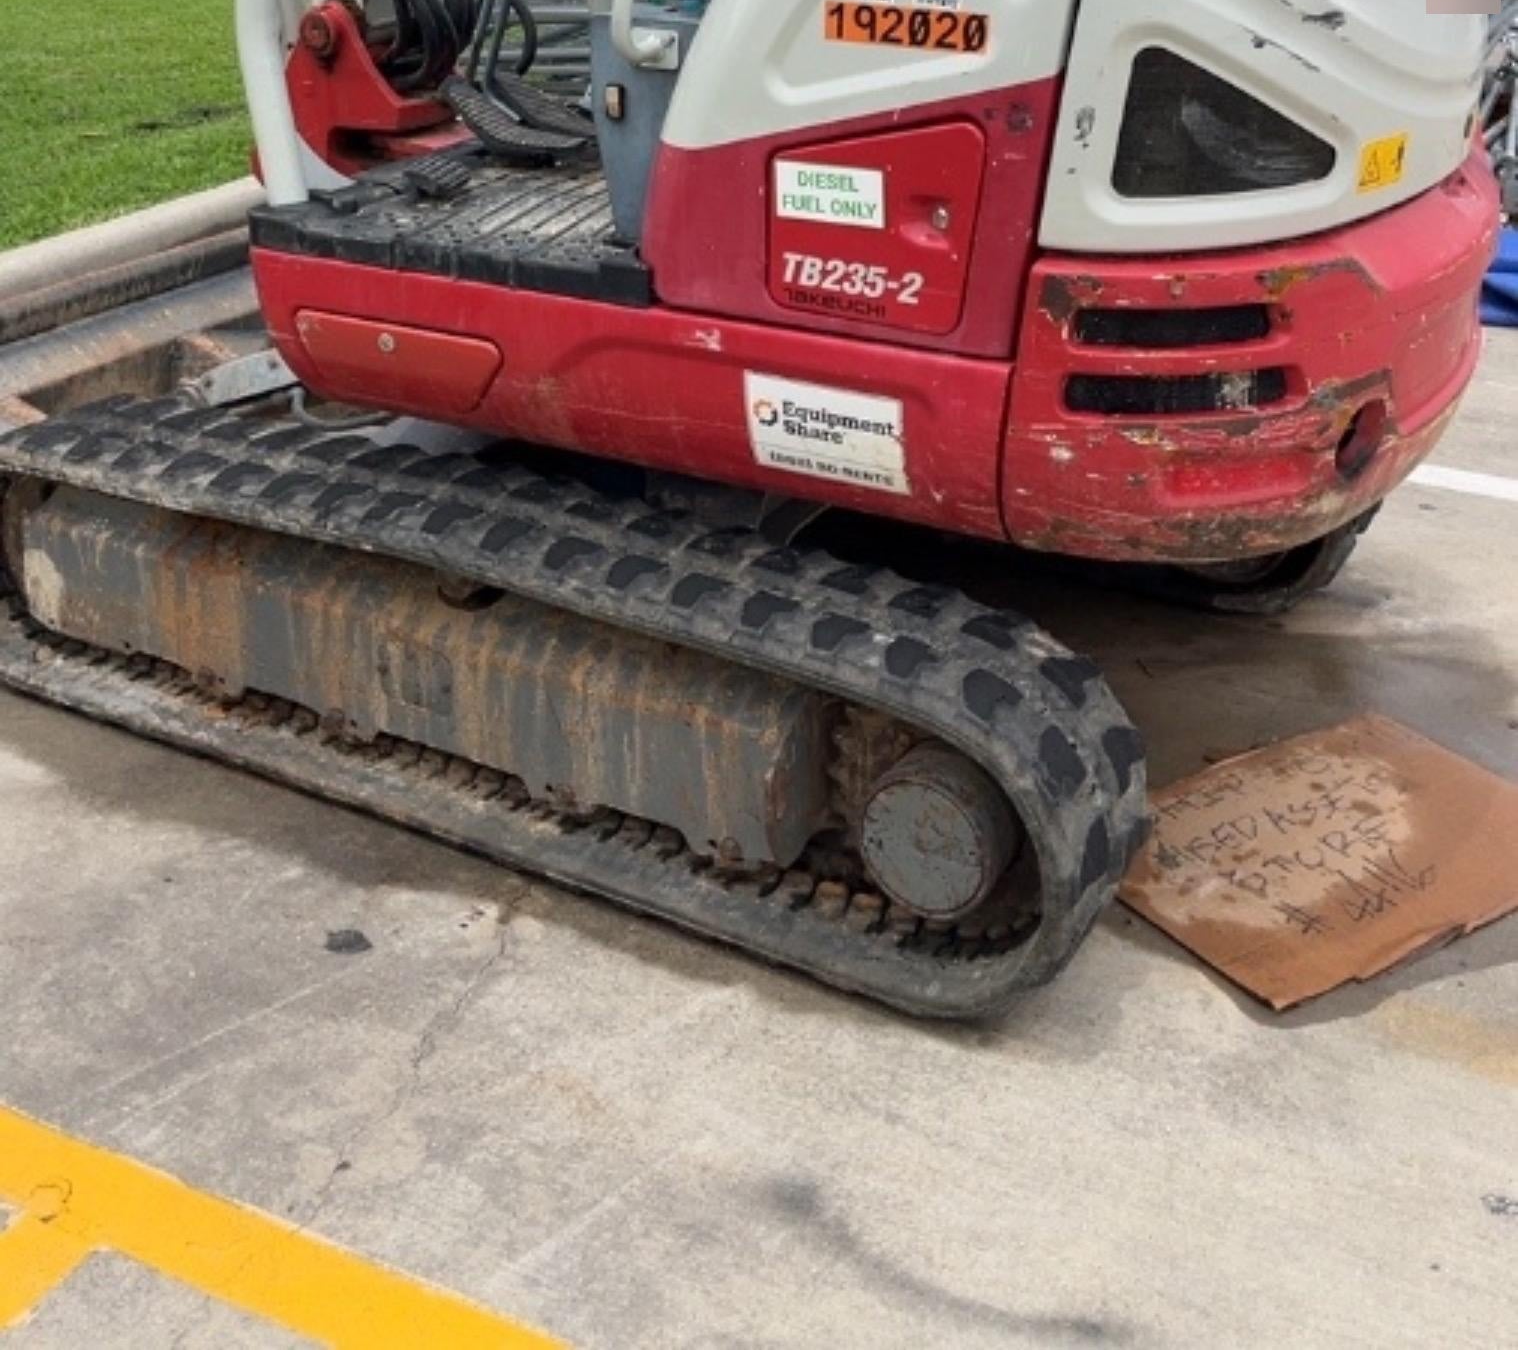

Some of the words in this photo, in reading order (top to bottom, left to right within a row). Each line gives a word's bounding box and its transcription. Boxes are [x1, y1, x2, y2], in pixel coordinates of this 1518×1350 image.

[828, 2, 989, 53] 192020
[797, 169, 860, 193] DIESEL
[782, 194, 826, 214] FUEL
[830, 197, 877, 220] ONLY
[783, 252, 925, 305] TB235-2
[782, 400, 895, 437] Equipment
[783, 419, 845, 445] Share
